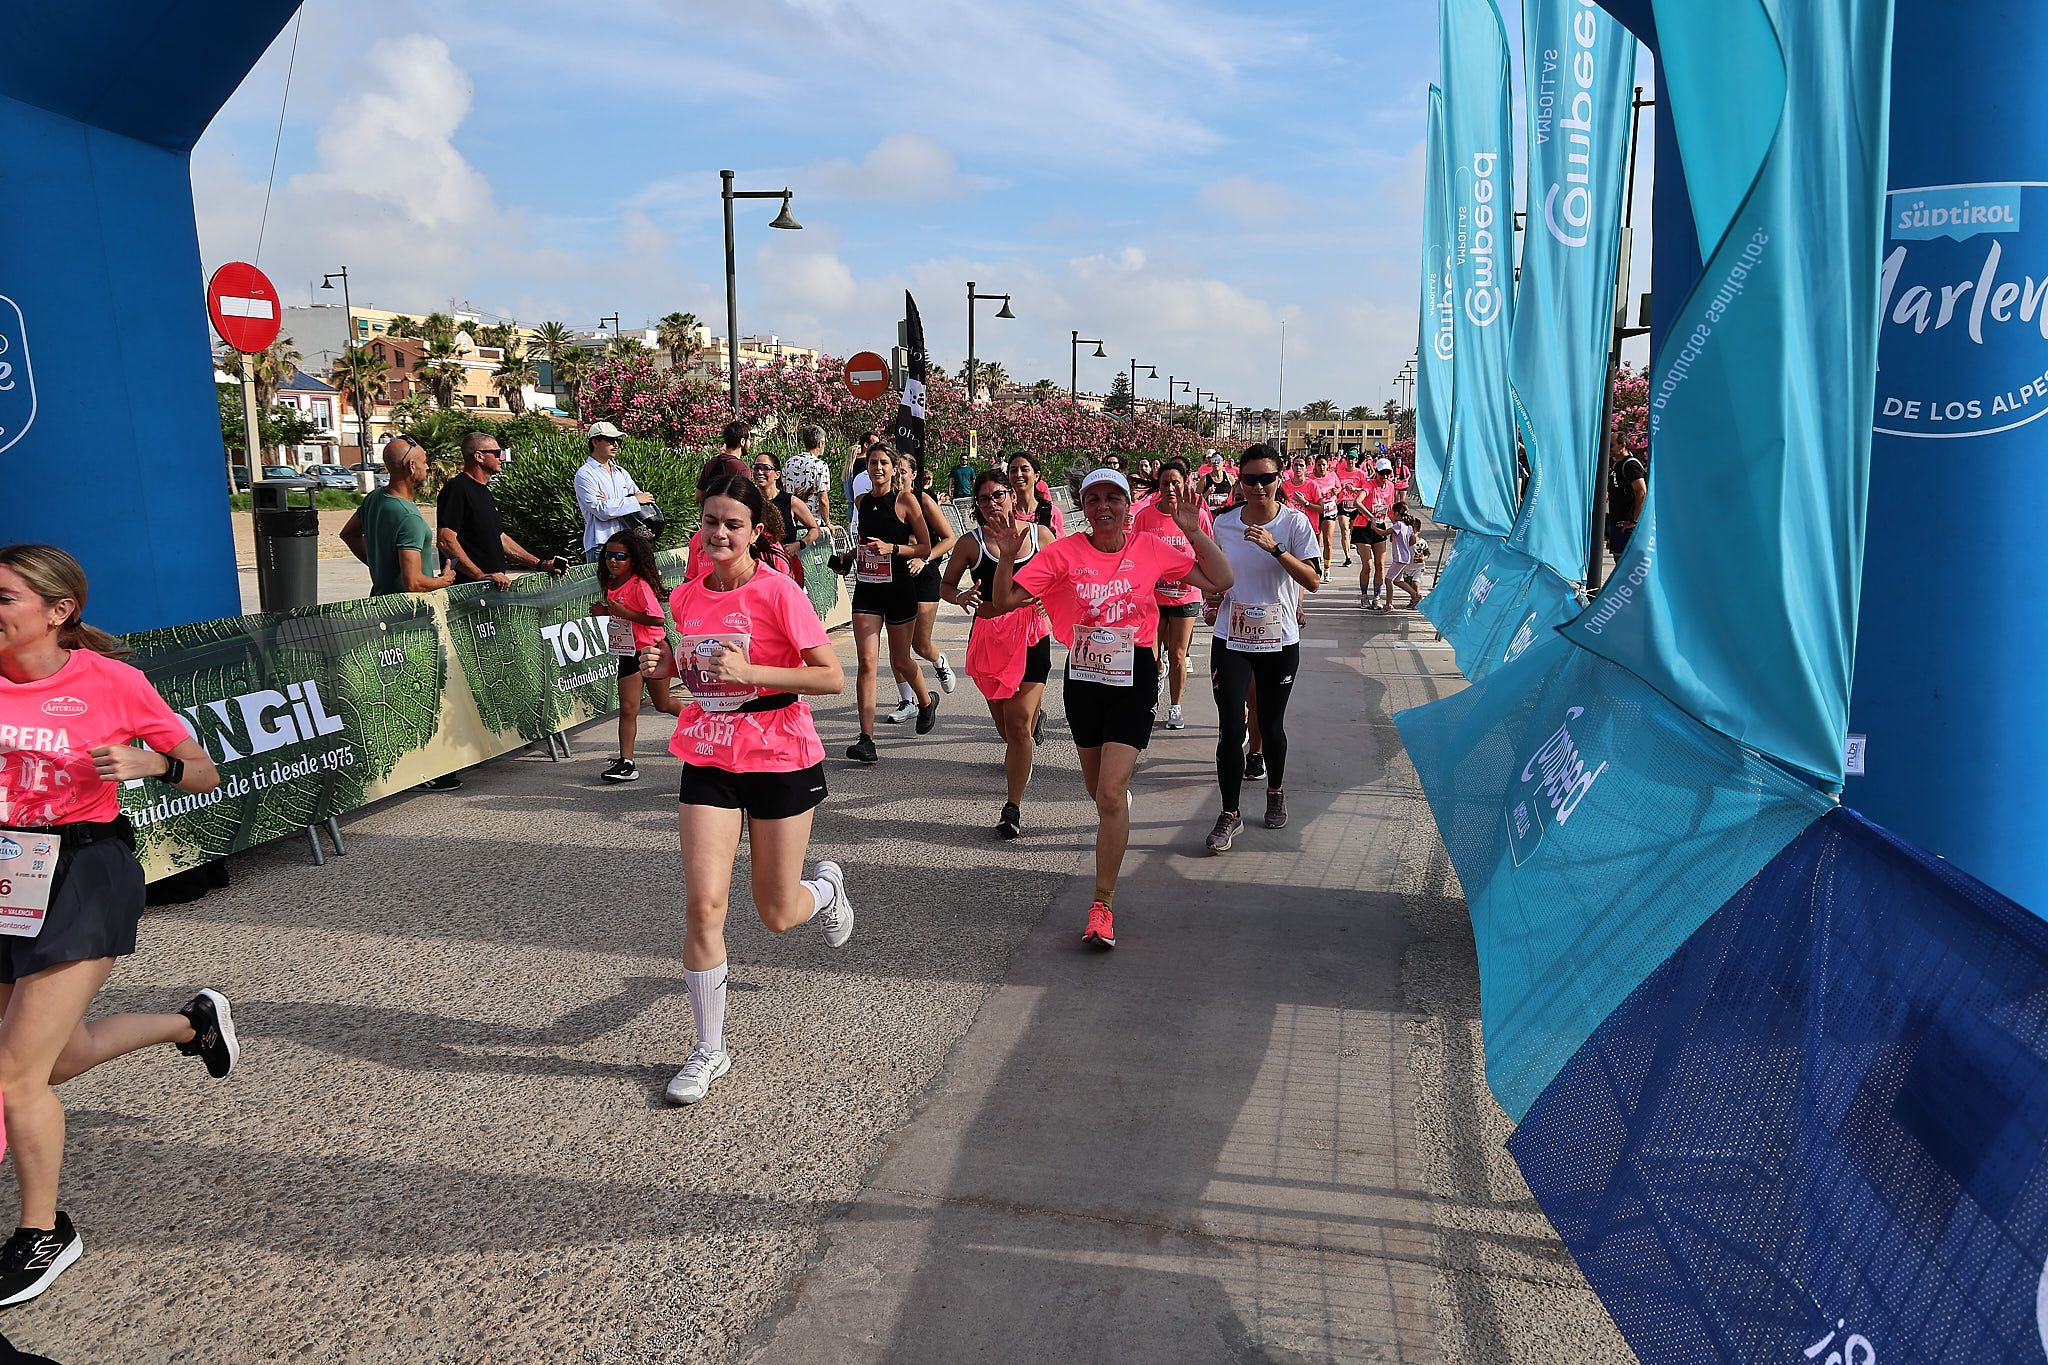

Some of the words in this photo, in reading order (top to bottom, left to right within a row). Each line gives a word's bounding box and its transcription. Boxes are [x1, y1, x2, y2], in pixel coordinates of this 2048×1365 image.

[1883, 397, 1921, 420] DE
[1930, 400, 1982, 421] LOS
[1076, 578, 1133, 600] CARRERA
[476, 621, 496, 640] 1975
[1245, 626, 1265, 635] 016
[378, 647, 405, 668] 2026
[1088, 652, 1112, 664] 016
[558, 667, 598, 692] Cuidando
[598, 663, 609, 679] de
[694, 741, 714, 756] 2026
[226, 773, 251, 799] de
[251, 766, 269, 791] ti
[270, 754, 319, 786] desde
[321, 744, 354, 772] 1975
[1521, 706, 1607, 827] Compeed
[8, 908, 34, 917] VALENCIA
